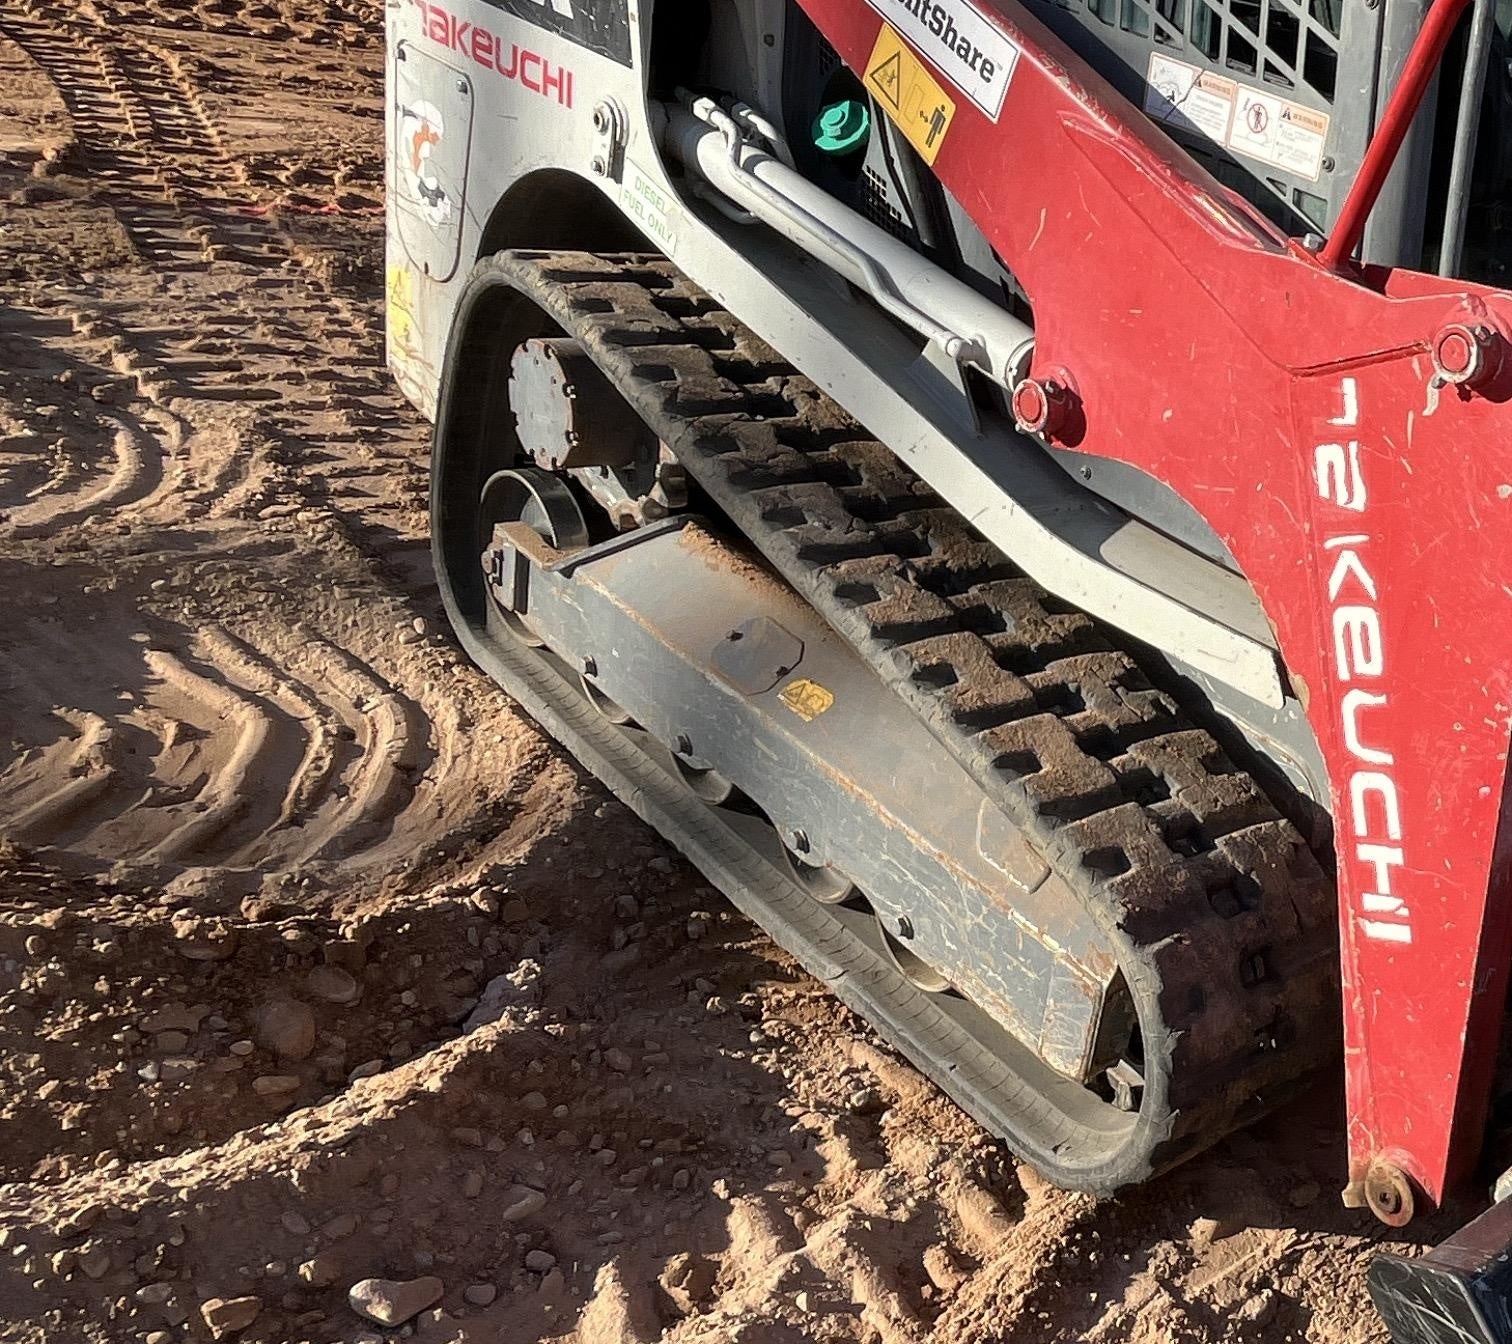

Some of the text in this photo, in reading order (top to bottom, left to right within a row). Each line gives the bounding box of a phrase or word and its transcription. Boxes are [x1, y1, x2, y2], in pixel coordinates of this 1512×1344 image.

[623, 189, 673, 244] FUEL ONLY
[634, 175, 667, 218] DIESEL
